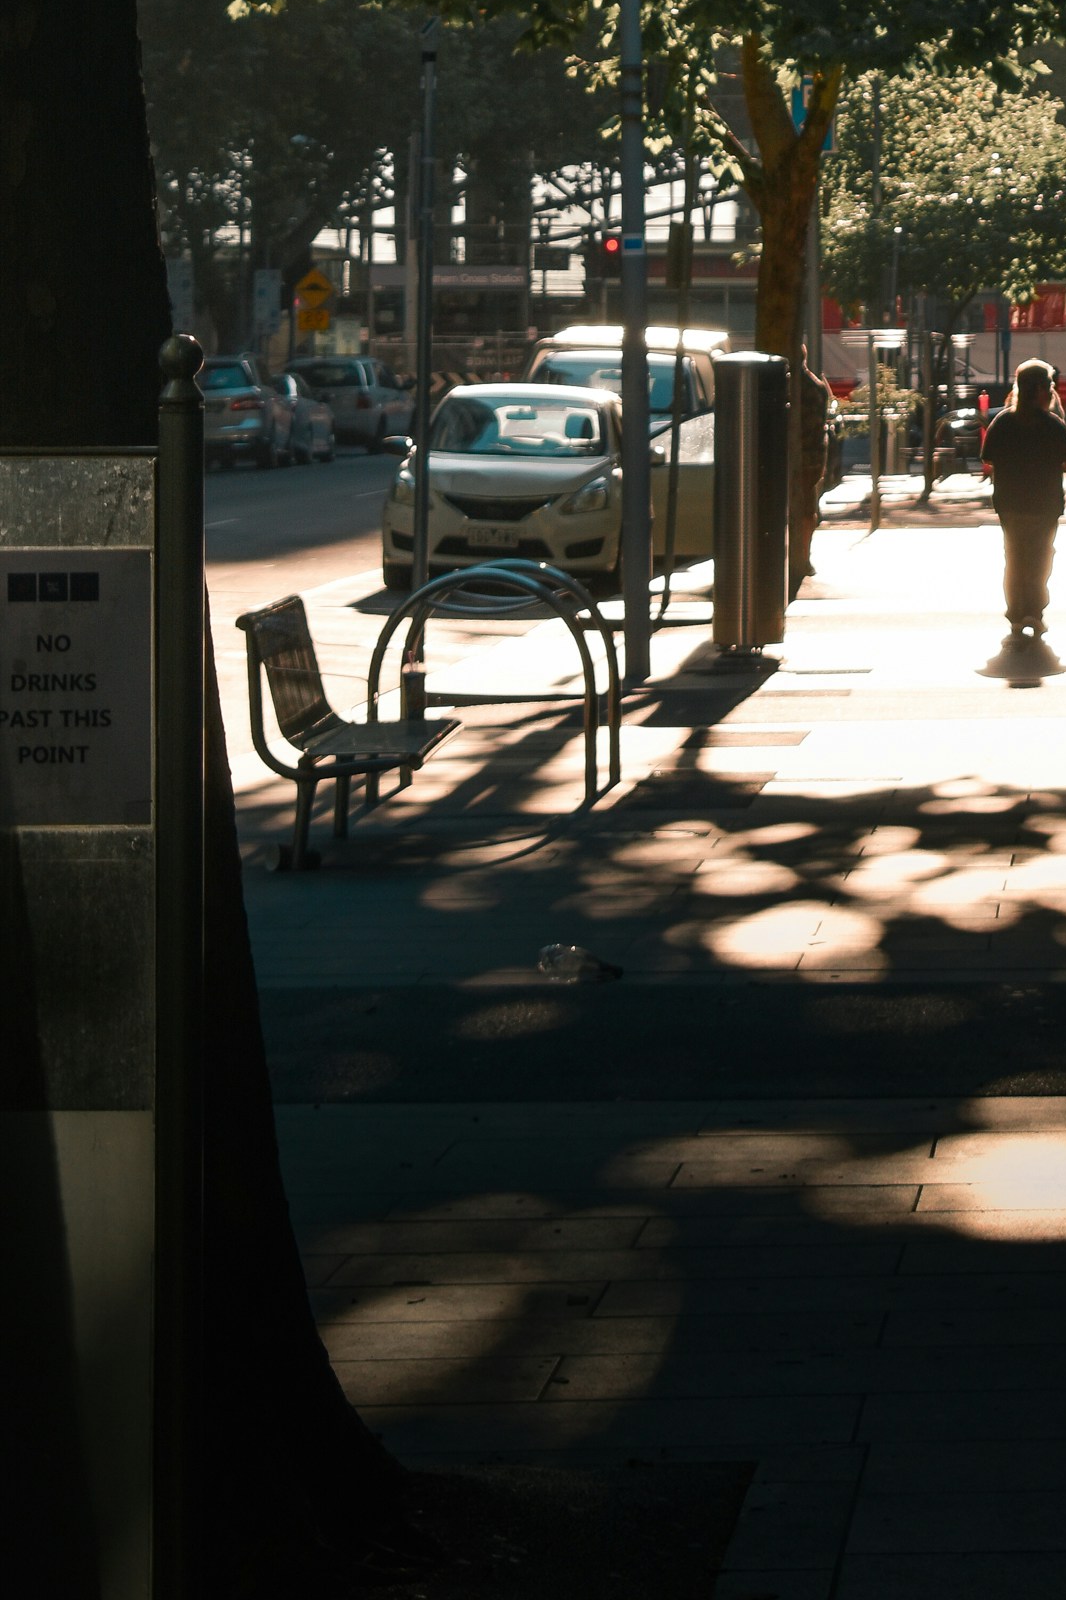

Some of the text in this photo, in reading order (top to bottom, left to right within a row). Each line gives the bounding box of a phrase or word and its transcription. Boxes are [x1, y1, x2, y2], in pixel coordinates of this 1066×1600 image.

[491, 273, 524, 283] Station
[36, 634, 71, 652] NO
[11, 673, 97, 692] DRINKS
[0, 709, 112, 728] PAST THIS
[18, 746, 90, 764] POINT
